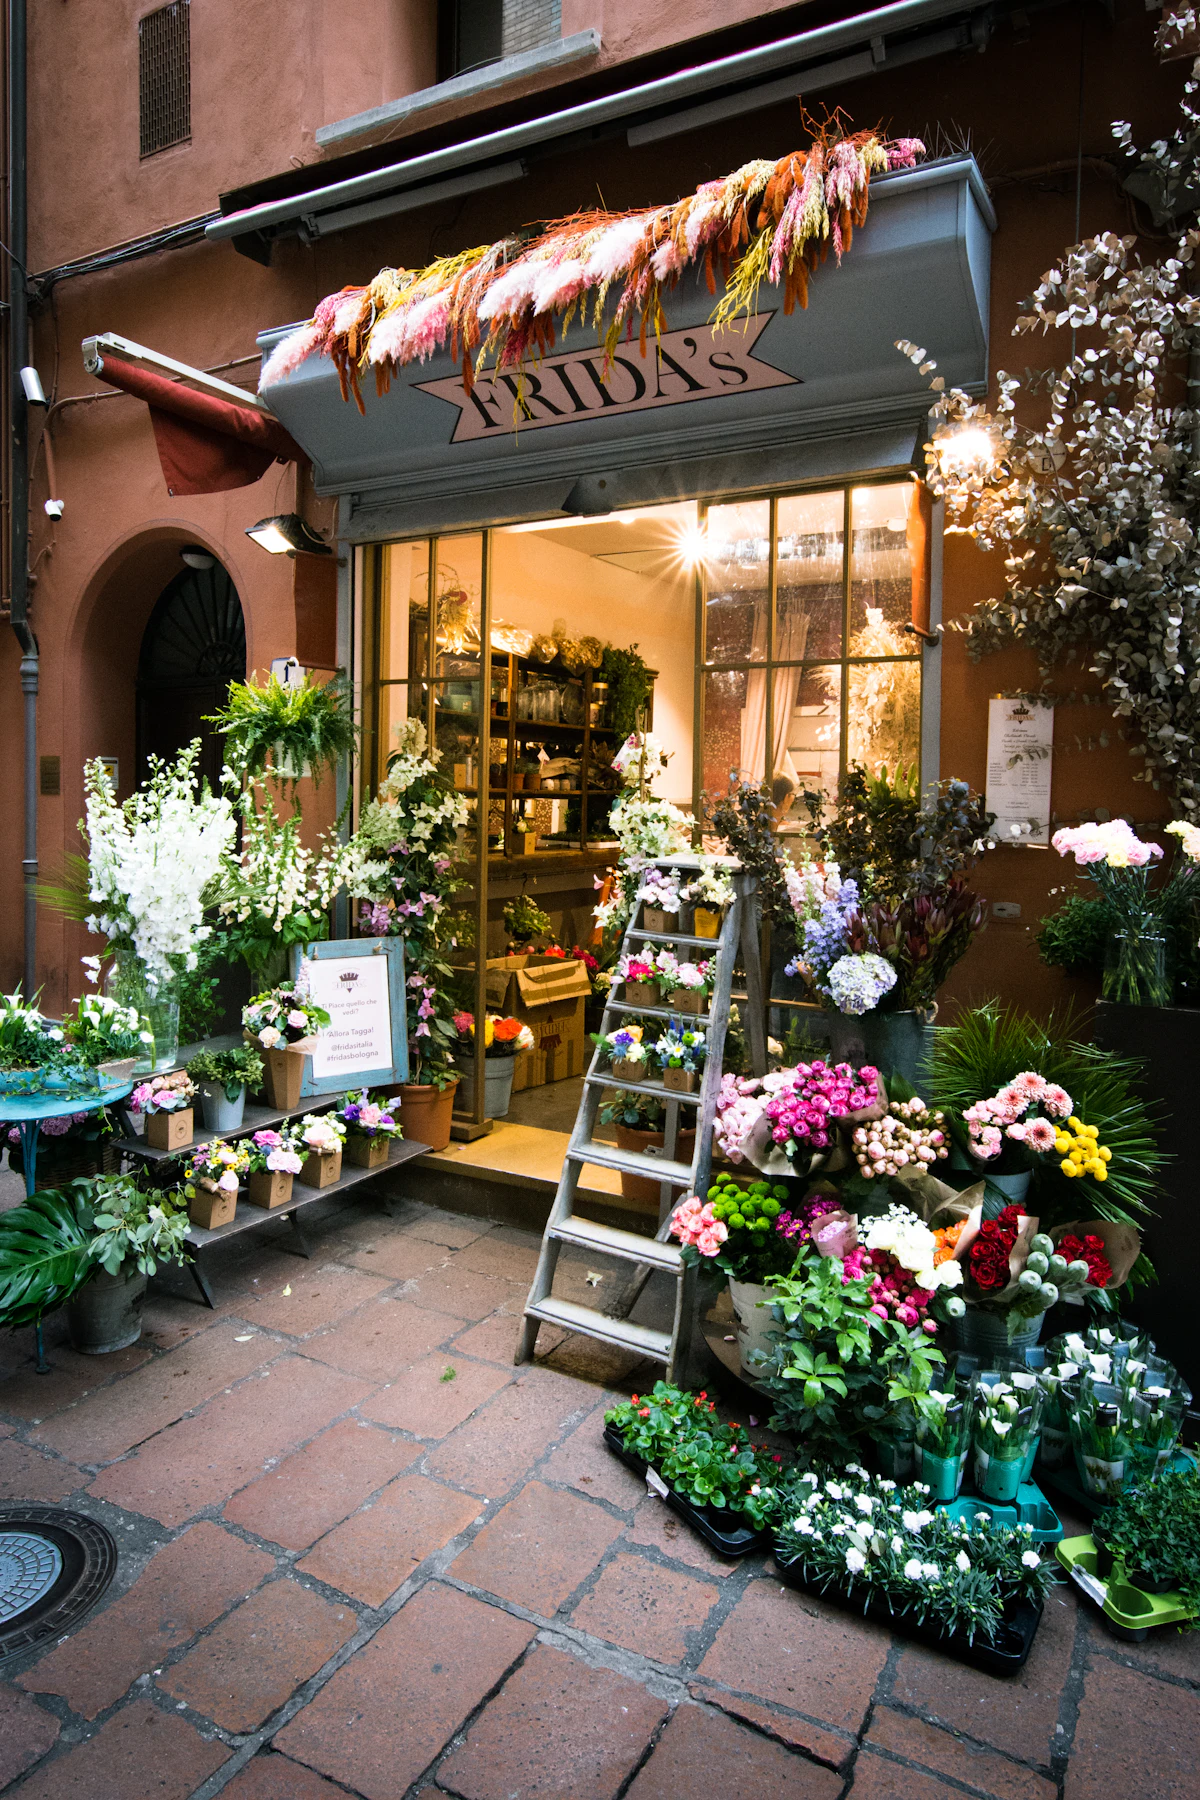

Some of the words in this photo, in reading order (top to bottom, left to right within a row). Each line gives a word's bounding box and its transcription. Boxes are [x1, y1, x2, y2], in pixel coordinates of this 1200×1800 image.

[346, 1000, 365, 1008] quello
[366, 998, 377, 1006] che
[342, 1008, 359, 1016] vedi?
[351, 1026, 374, 1037] Tagga!
[331, 1040, 373, 1051] @fridasitalia
[327, 1050, 379, 1062] #fridasbologna
